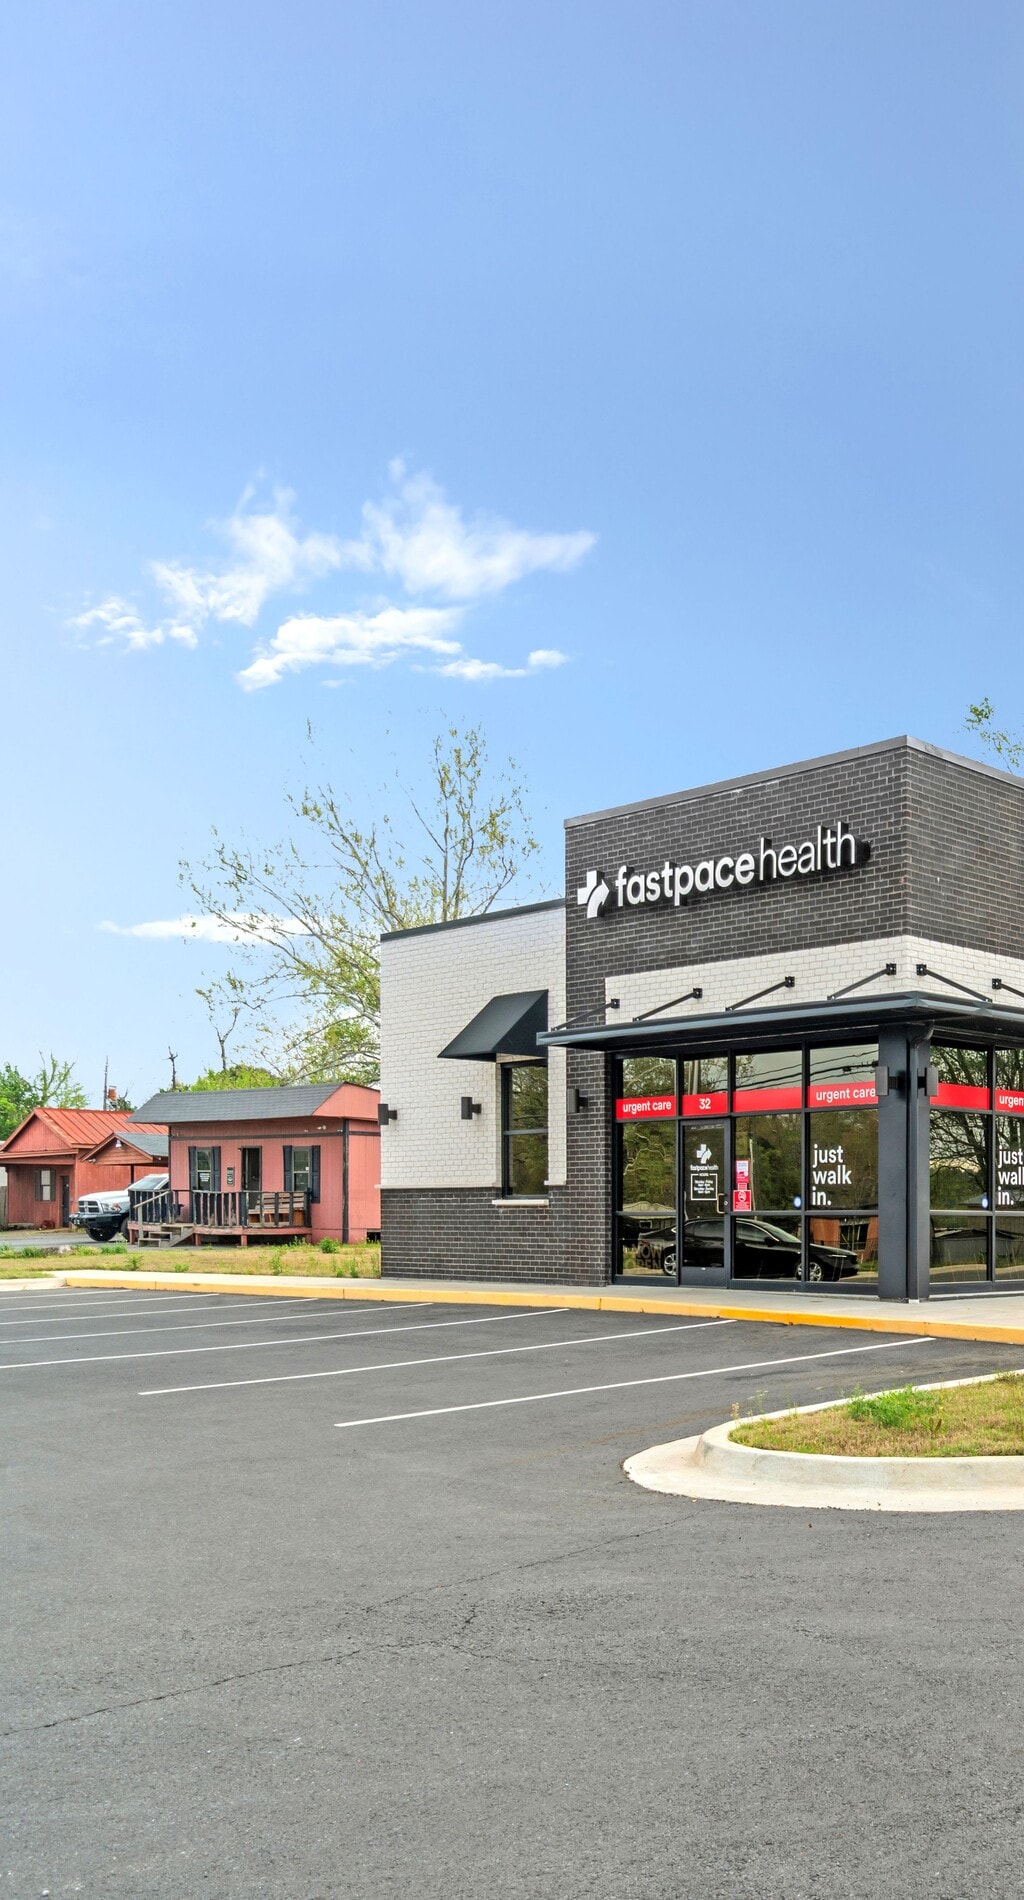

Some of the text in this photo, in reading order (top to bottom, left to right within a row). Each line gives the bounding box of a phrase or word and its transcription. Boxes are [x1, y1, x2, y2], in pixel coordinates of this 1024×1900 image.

[699, 1098, 711, 1110] 32
[815, 1087, 876, 1103] urgent care
[622, 1101, 672, 1115] urgent care
[812, 1143, 844, 1168] just
[998, 1145, 1024, 1169] just
[812, 1165, 852, 1184] walk
[812, 1186, 832, 1205] in.
[998, 1186, 1014, 1205] in.
